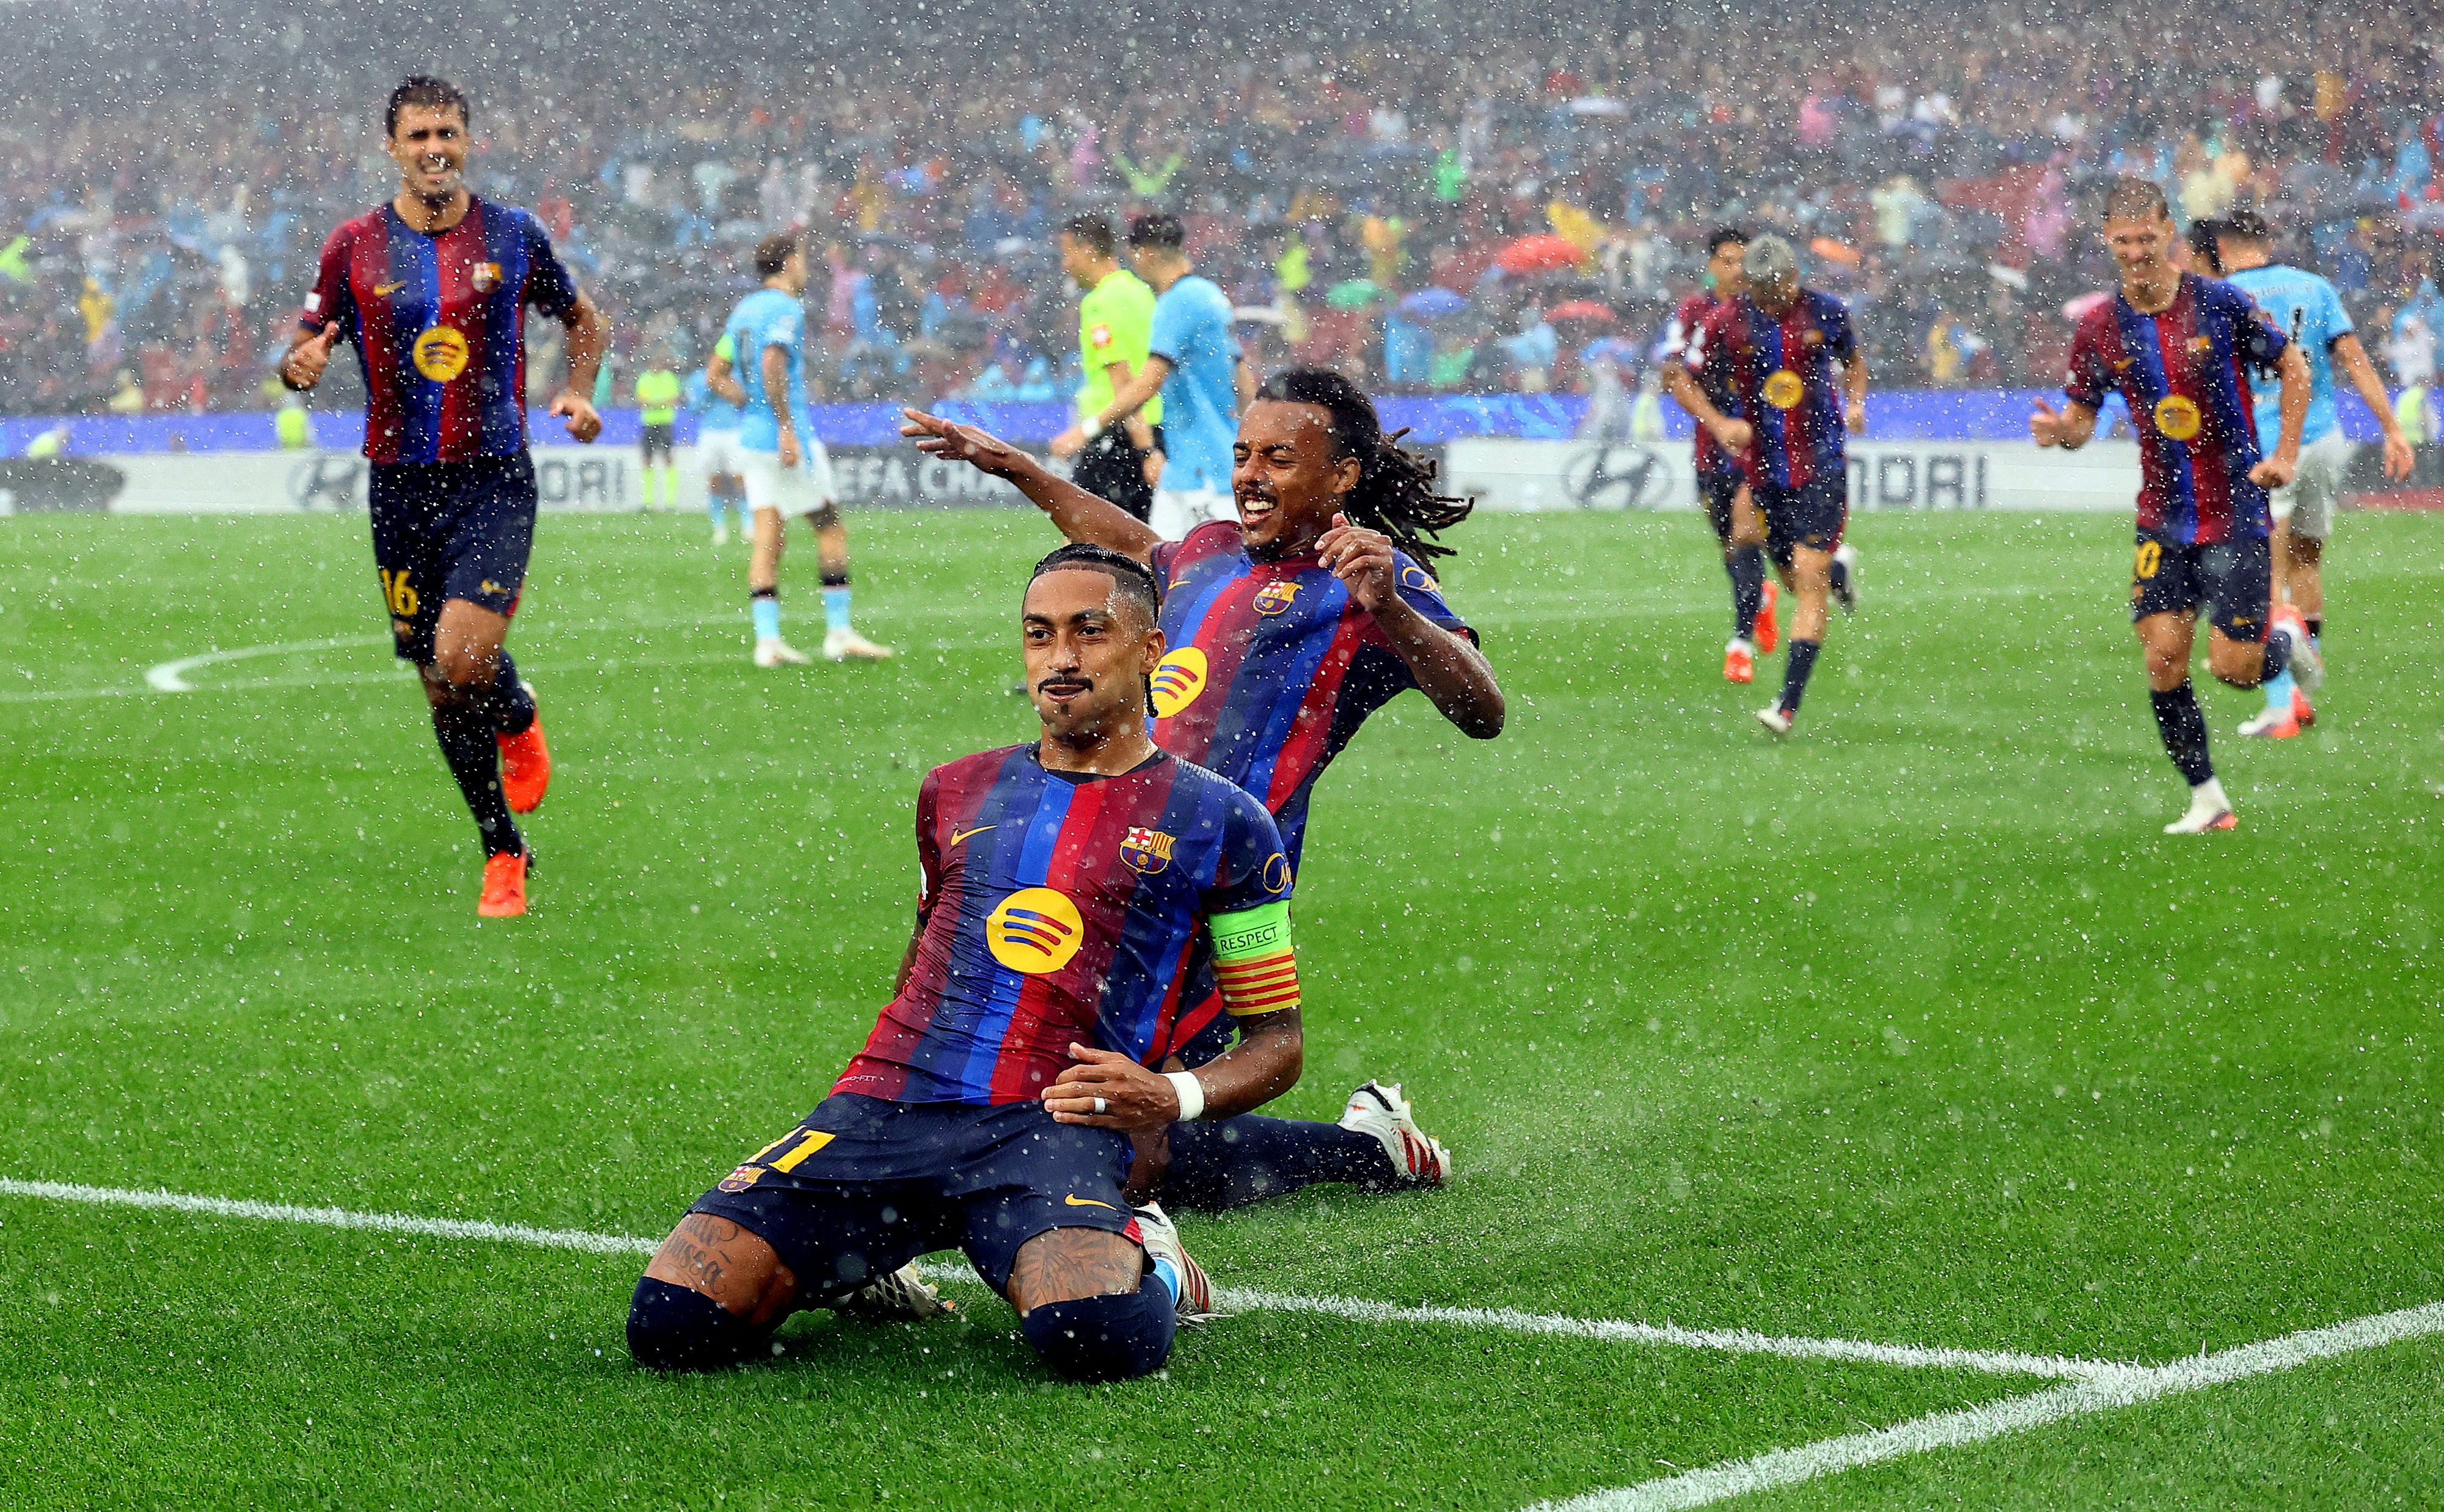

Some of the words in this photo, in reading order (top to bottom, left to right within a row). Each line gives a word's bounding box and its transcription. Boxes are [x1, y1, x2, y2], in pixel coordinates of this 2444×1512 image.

[835, 458, 909, 499] EFA
[2135, 539, 2162, 579] 0
[381, 568, 419, 617] 16
[1136, 844, 1157, 854] FCB
[1220, 926, 1277, 951] RESPECT
